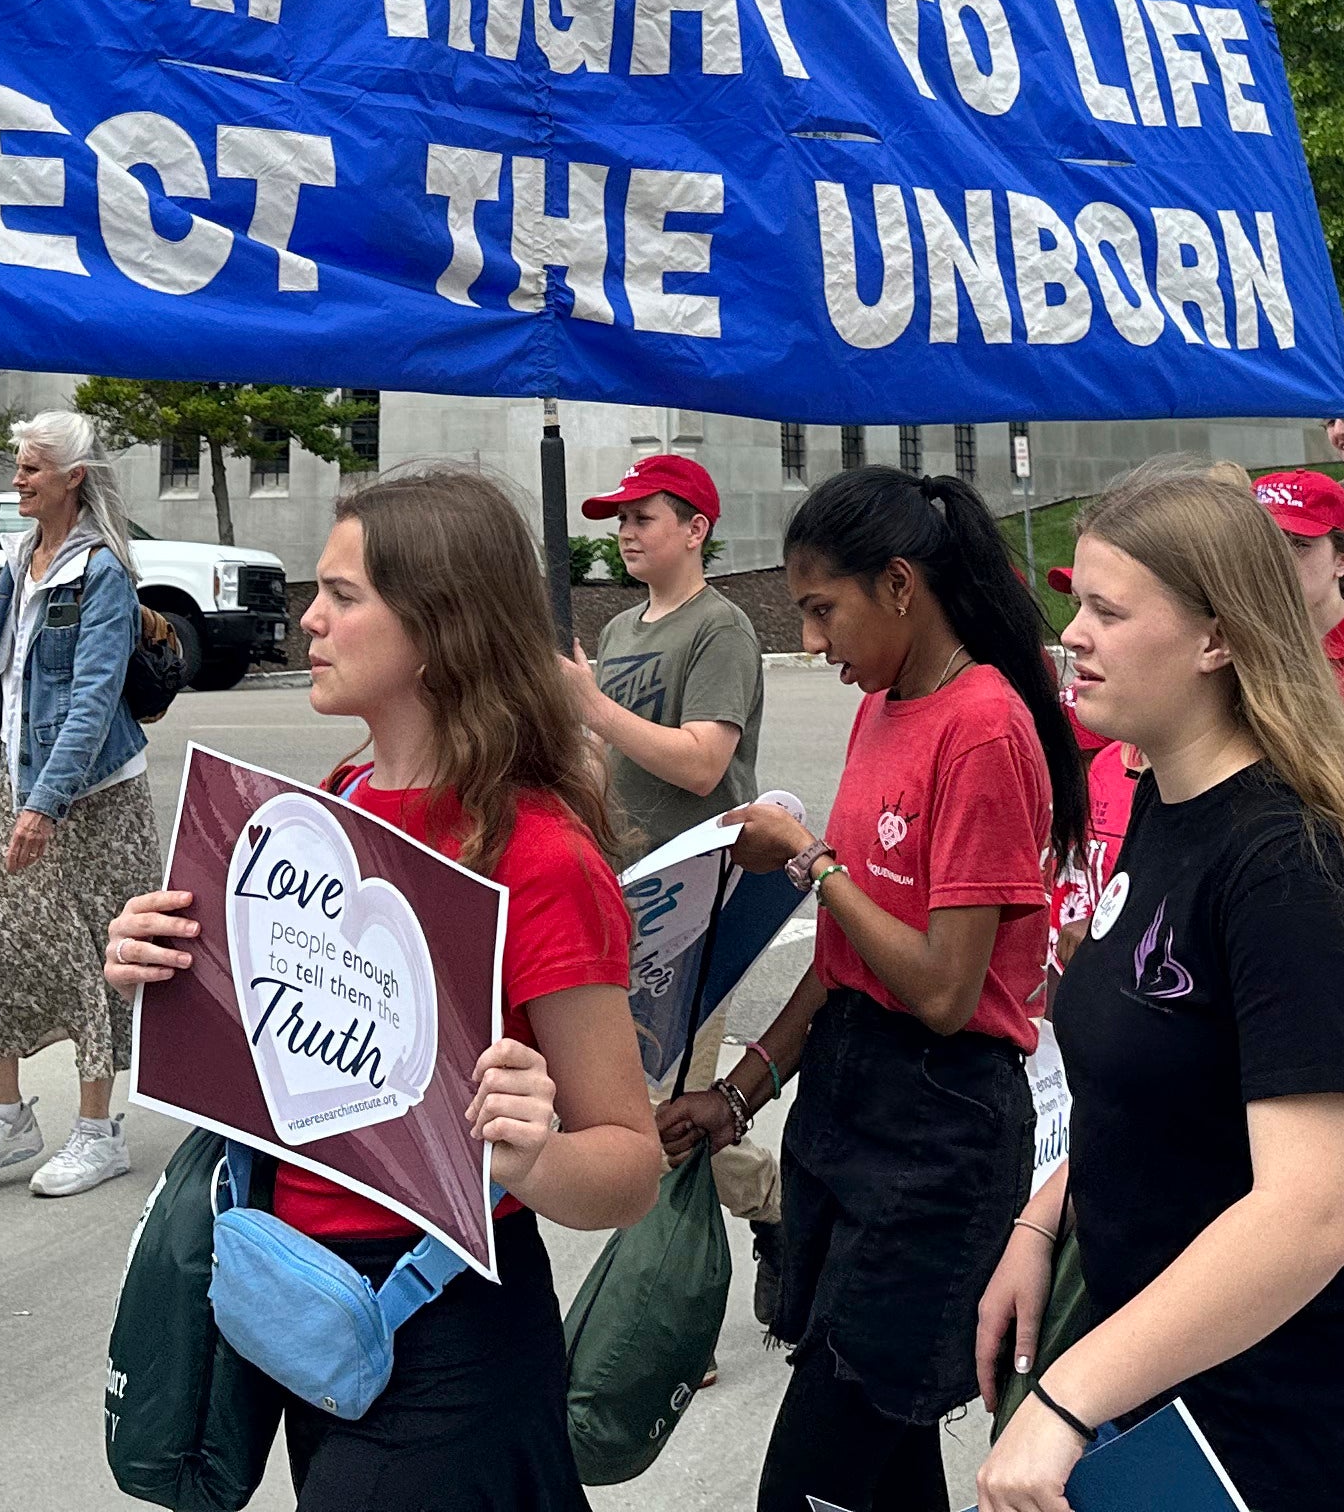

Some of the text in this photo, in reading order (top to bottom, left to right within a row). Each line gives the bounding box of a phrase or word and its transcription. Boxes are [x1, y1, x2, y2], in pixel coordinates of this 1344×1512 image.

[425, 143, 724, 339] THE
[814, 179, 1295, 351] UNBORN
[234, 826, 344, 920] Love
[623, 877, 686, 938] er
[269, 951, 400, 1029] to tell them the
[270, 921, 400, 999] people enough
[631, 950, 673, 995] her
[250, 977, 387, 1089] Truth
[287, 1093, 399, 1131] vitaeresearchinstitute.org
[1035, 1067, 1064, 1093] enough
